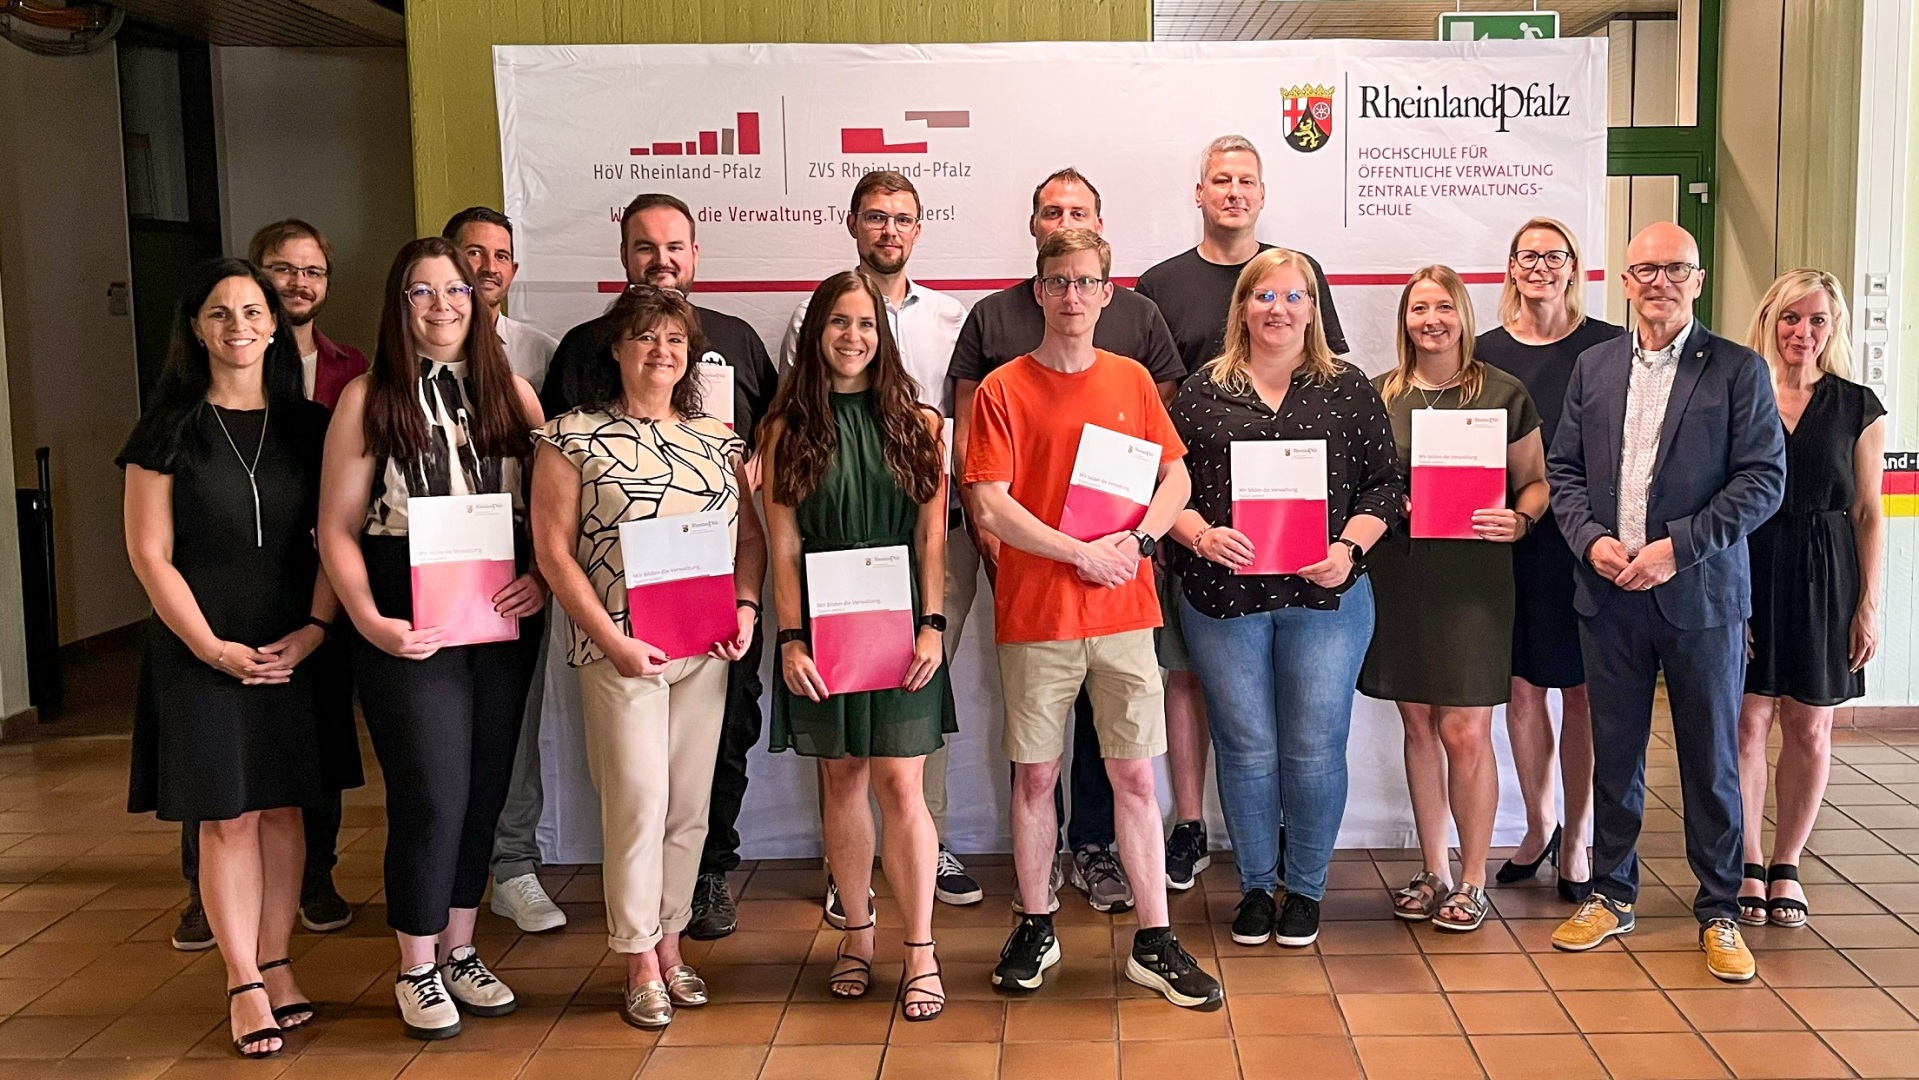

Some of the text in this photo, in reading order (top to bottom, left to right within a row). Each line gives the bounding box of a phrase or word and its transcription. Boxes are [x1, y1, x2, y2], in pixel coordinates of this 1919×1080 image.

[1358, 145, 1488, 160] HOCHSCHULE FÜR
[594, 163, 762, 180] HöV Rheinland-Pfalz
[809, 162, 835, 178] ZVS
[1358, 164, 1553, 178] ÖFFENTLICHE VERWALTUNG
[1358, 183, 1543, 198] ZENTRALE VERWALTUNGS-
[698, 206, 722, 222] die
[1358, 204, 1412, 216] SCHULE
